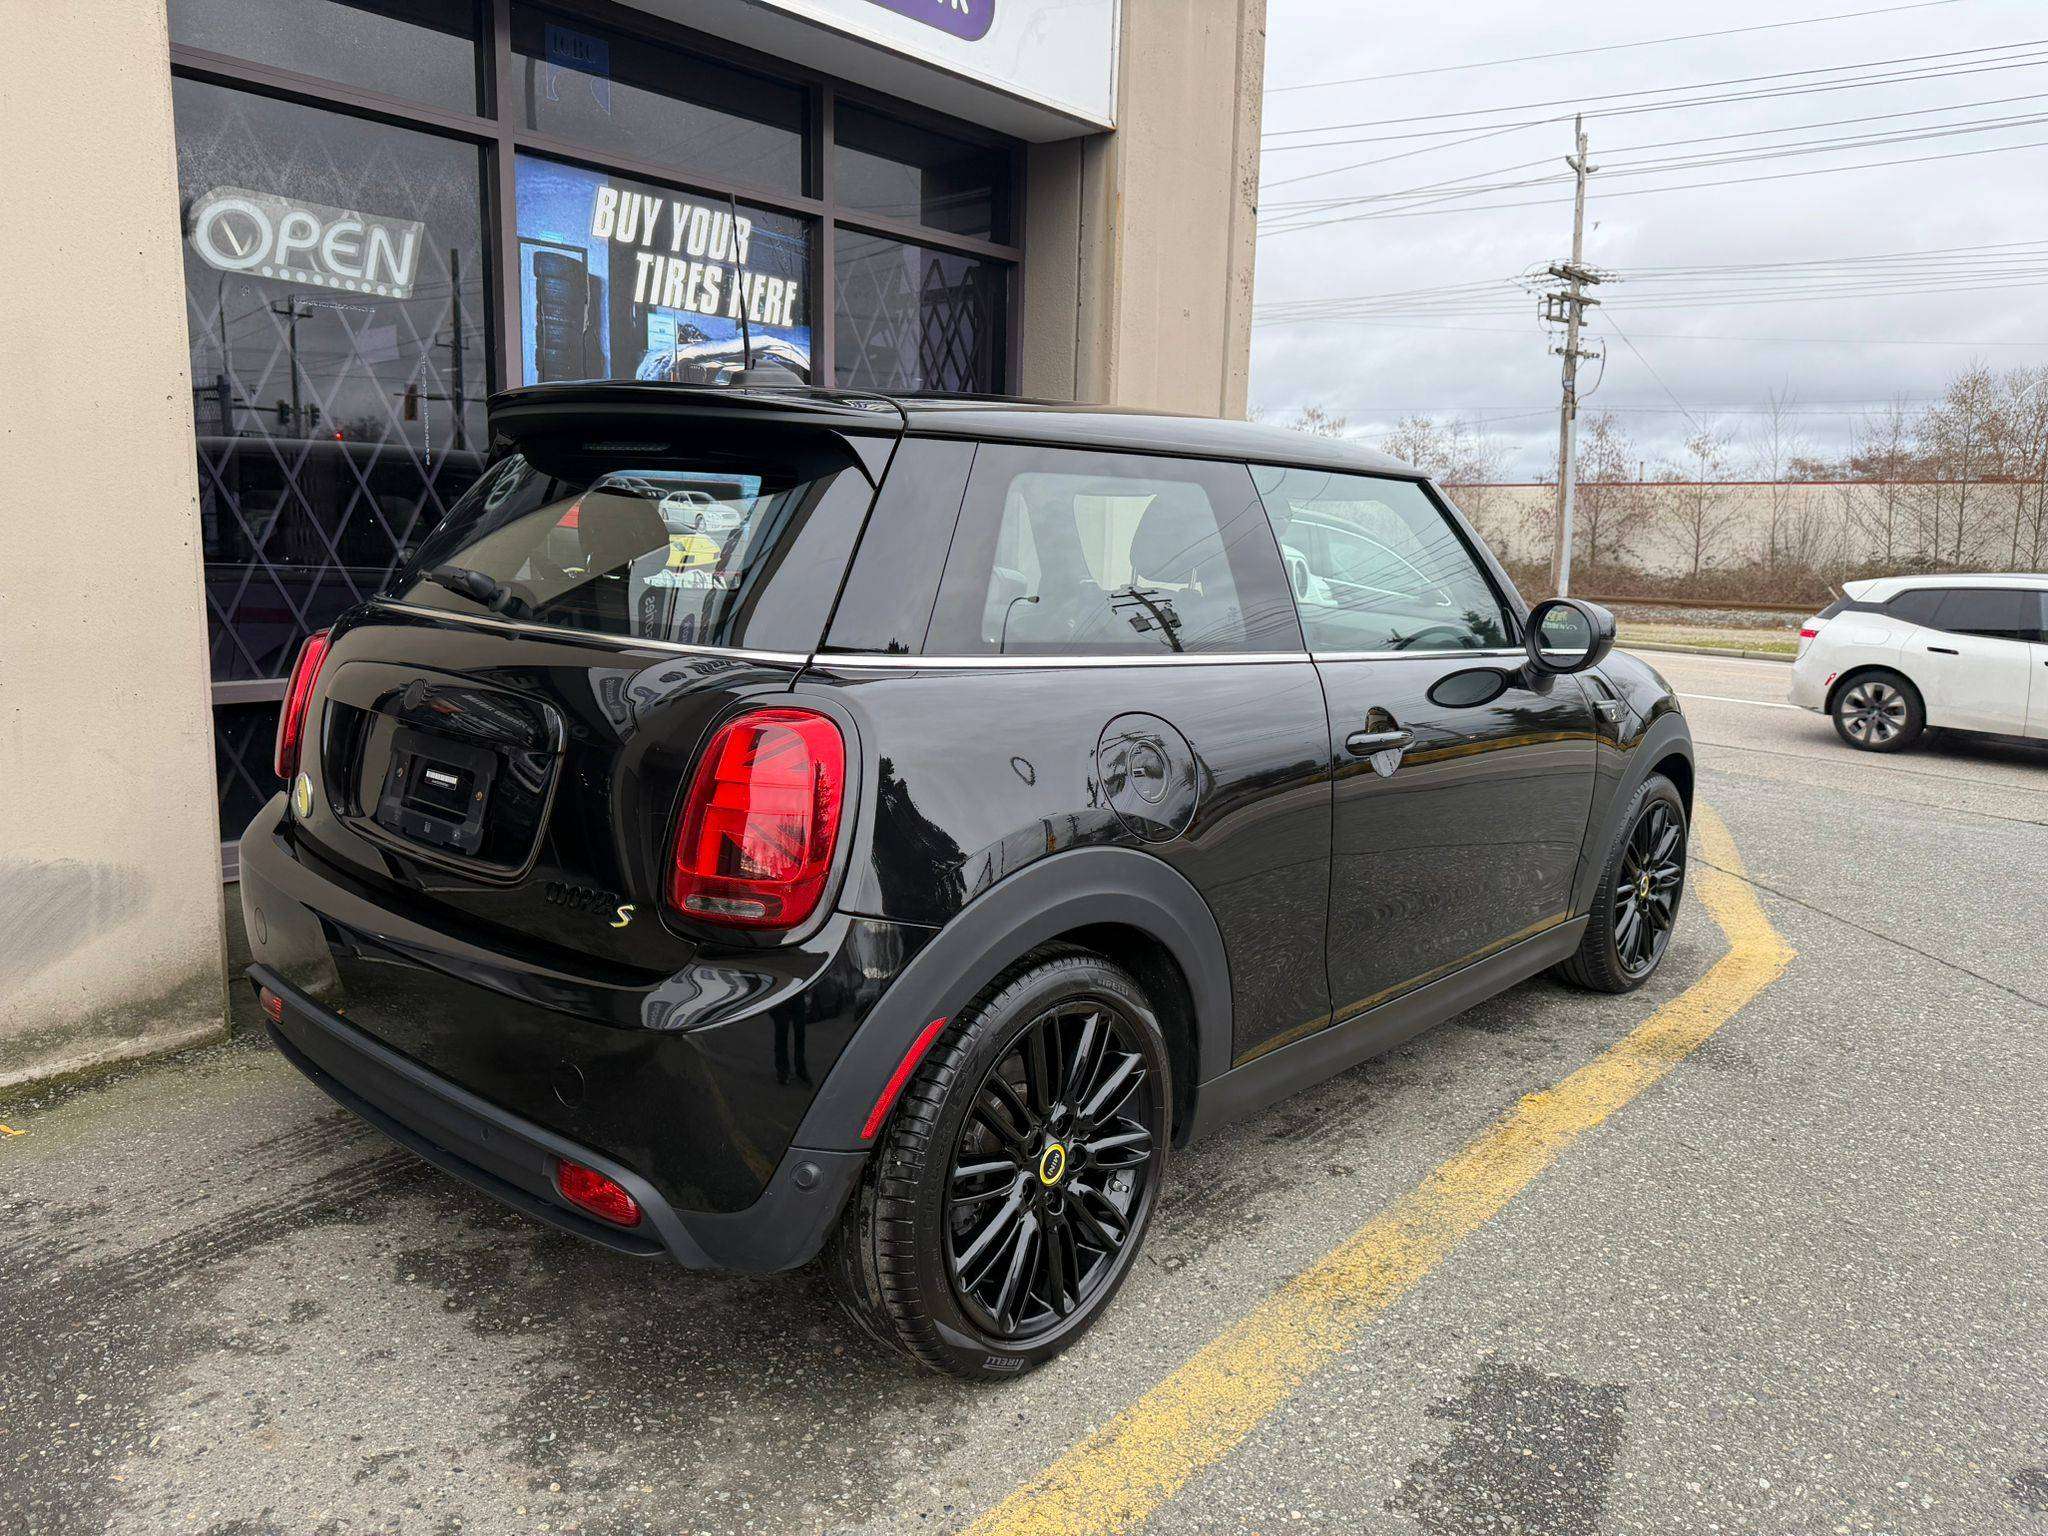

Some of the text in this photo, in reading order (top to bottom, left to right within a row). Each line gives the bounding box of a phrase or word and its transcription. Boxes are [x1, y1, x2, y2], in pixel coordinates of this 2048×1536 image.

[196, 199, 415, 286] OPEN
[592, 186, 751, 264] BUY YOUR
[634, 252, 798, 327] TIRES HERE
[609, 904, 635, 928] S
[1047, 1153, 1060, 1176] MINI
